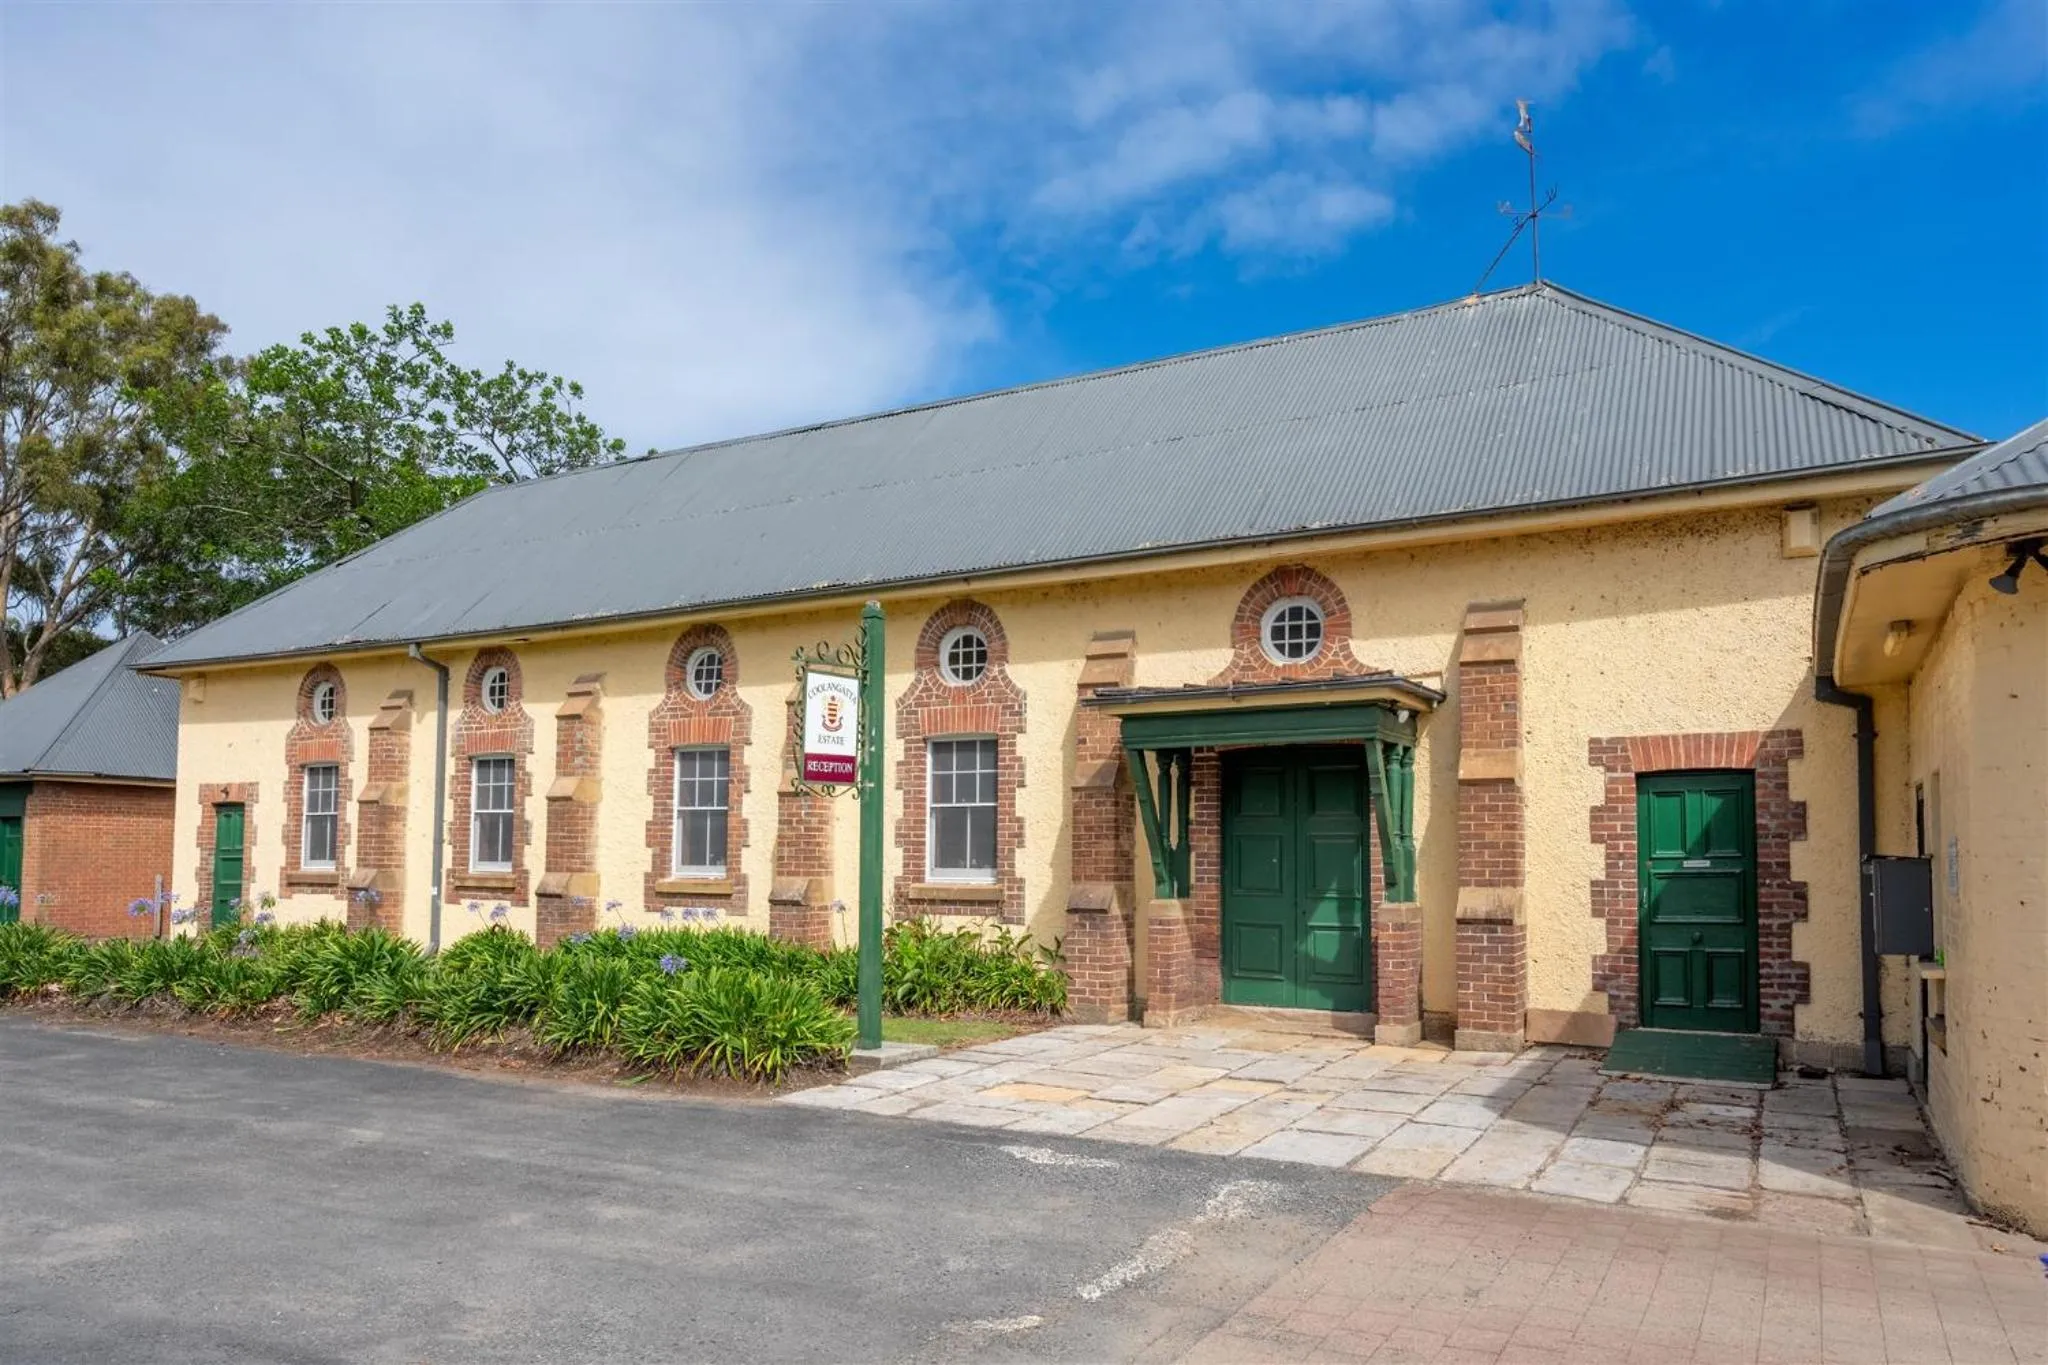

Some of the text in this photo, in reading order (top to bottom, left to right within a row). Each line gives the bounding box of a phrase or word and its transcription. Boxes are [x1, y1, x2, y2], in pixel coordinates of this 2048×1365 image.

[807, 682, 857, 704] COOLANGATTA
[817, 734, 845, 746] ESTATE
[807, 760, 853, 773] RECEPTION
